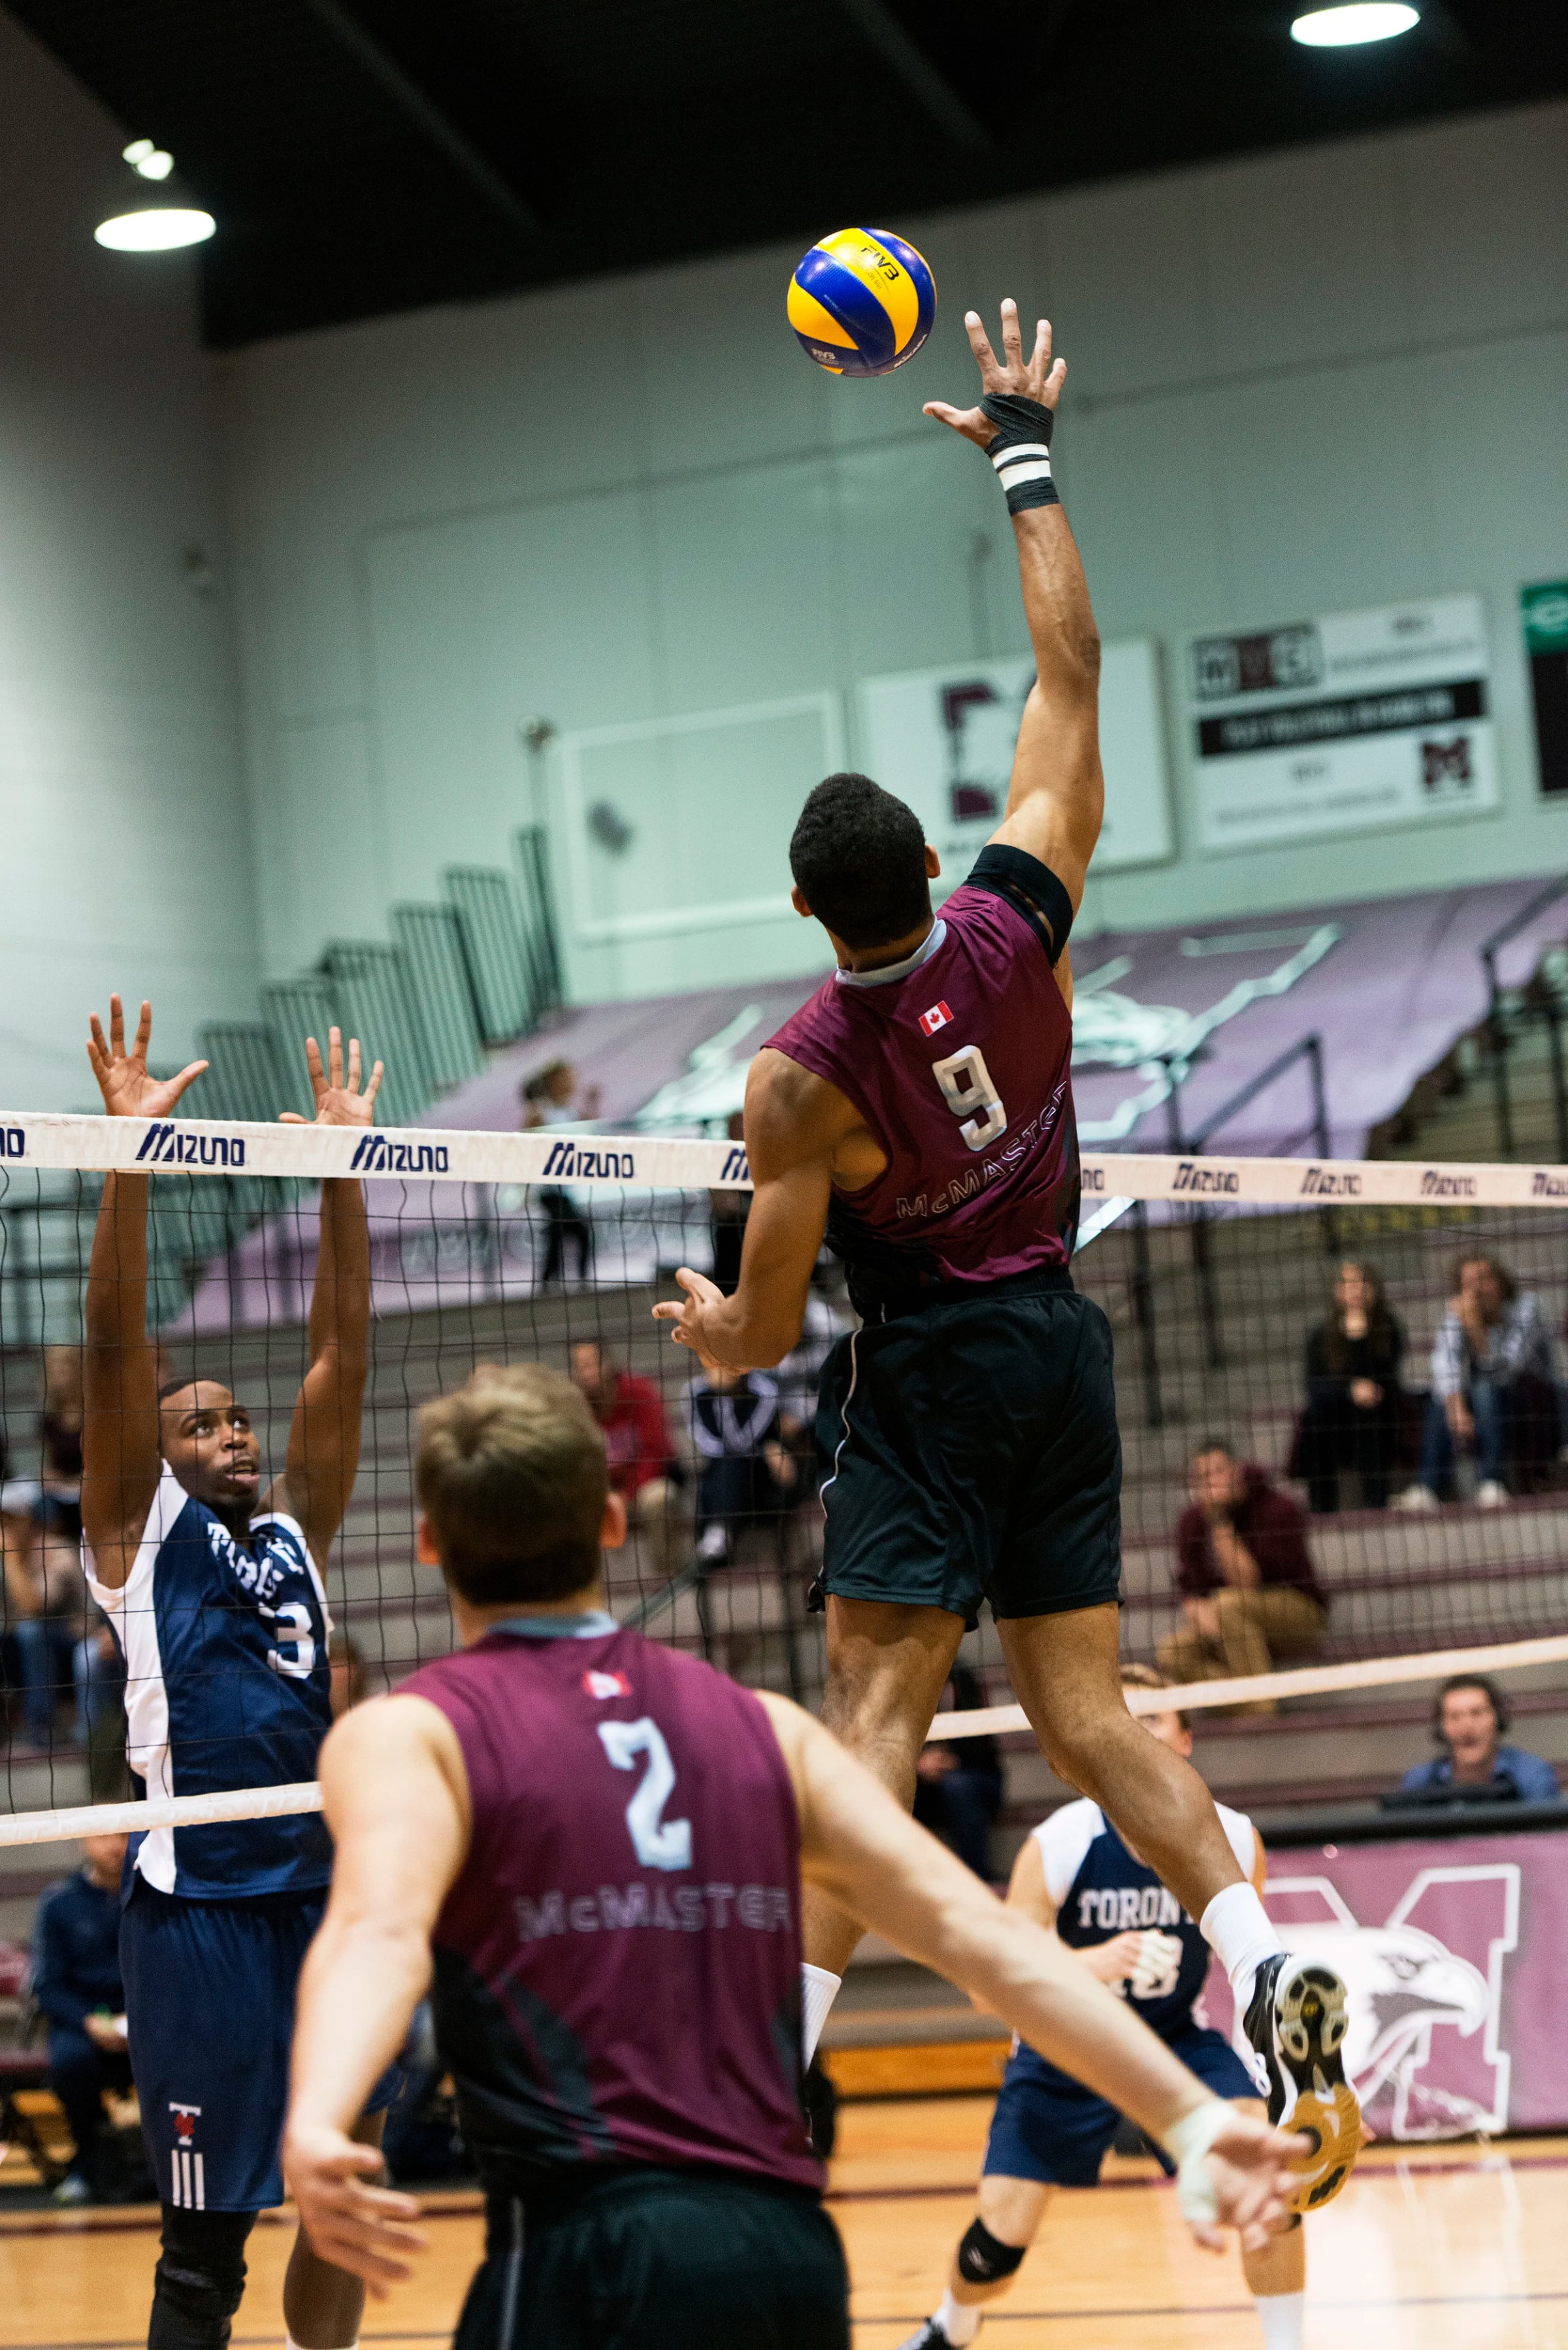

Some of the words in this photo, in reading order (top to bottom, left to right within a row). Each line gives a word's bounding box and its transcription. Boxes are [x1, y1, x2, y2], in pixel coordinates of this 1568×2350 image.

[860, 244, 900, 281] FIVB
[932, 1044, 1007, 1152] 9
[258, 1601, 314, 1680] 3
[597, 1717, 693, 1872] 2
[512, 1881, 793, 1942] McMASTER
[1079, 1886, 1194, 1929] TORON
